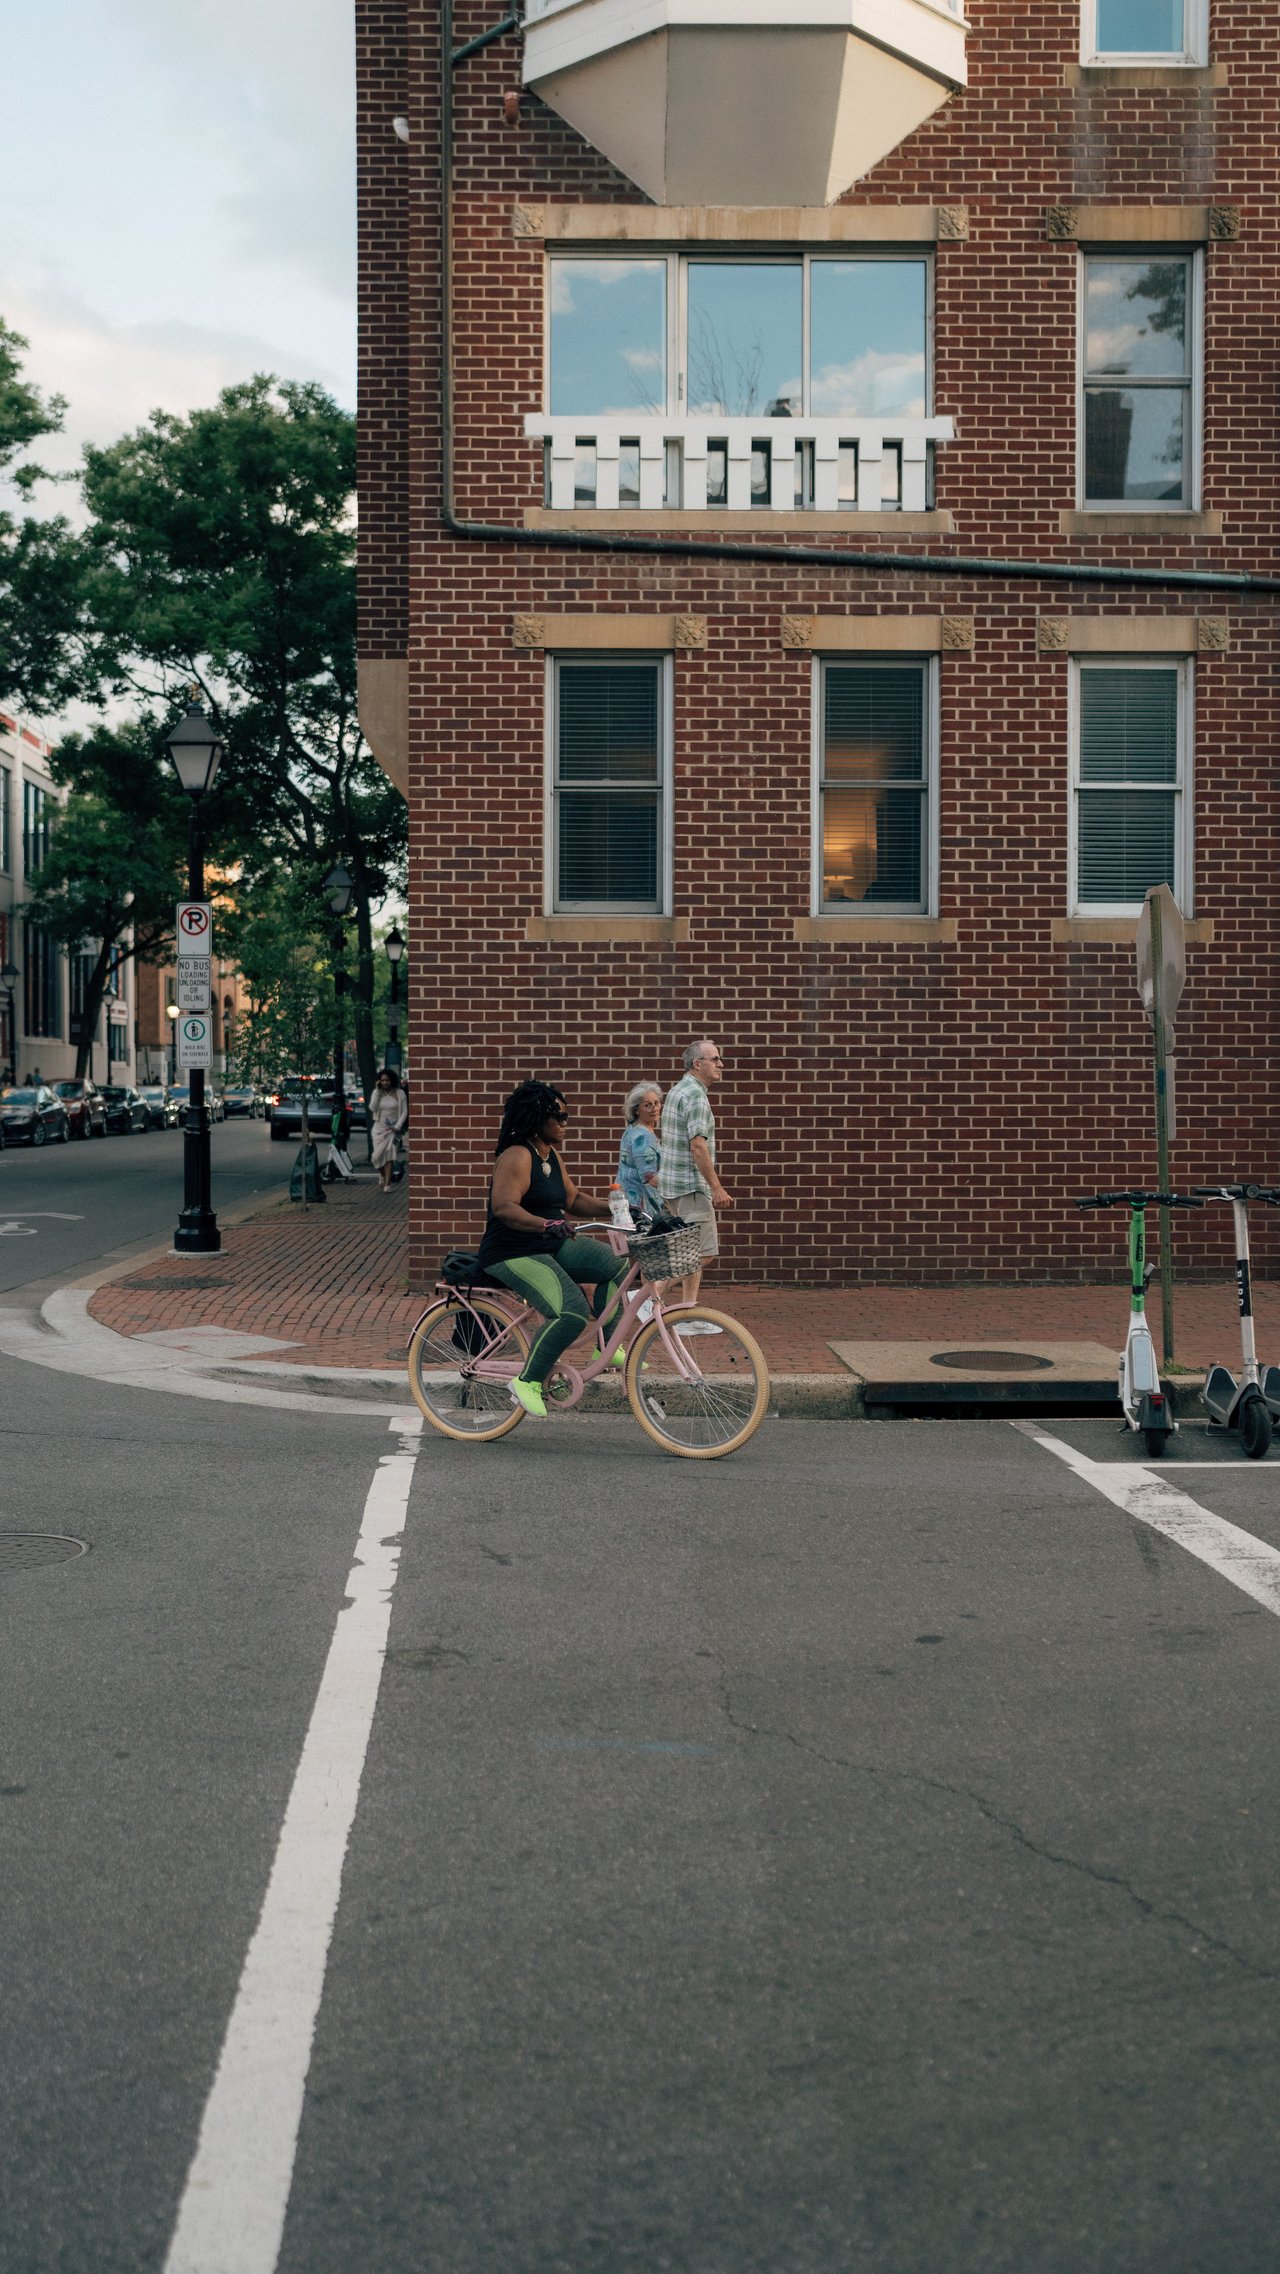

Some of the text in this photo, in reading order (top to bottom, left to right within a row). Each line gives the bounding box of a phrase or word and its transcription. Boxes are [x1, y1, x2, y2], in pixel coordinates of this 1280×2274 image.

[189, 911, 203, 930] P
[179, 961, 209, 970] NO BUS
[181, 971, 208, 979] LOADING
[179, 979, 209, 987] UNLOADING
[183, 994, 204, 1002] IDLING
